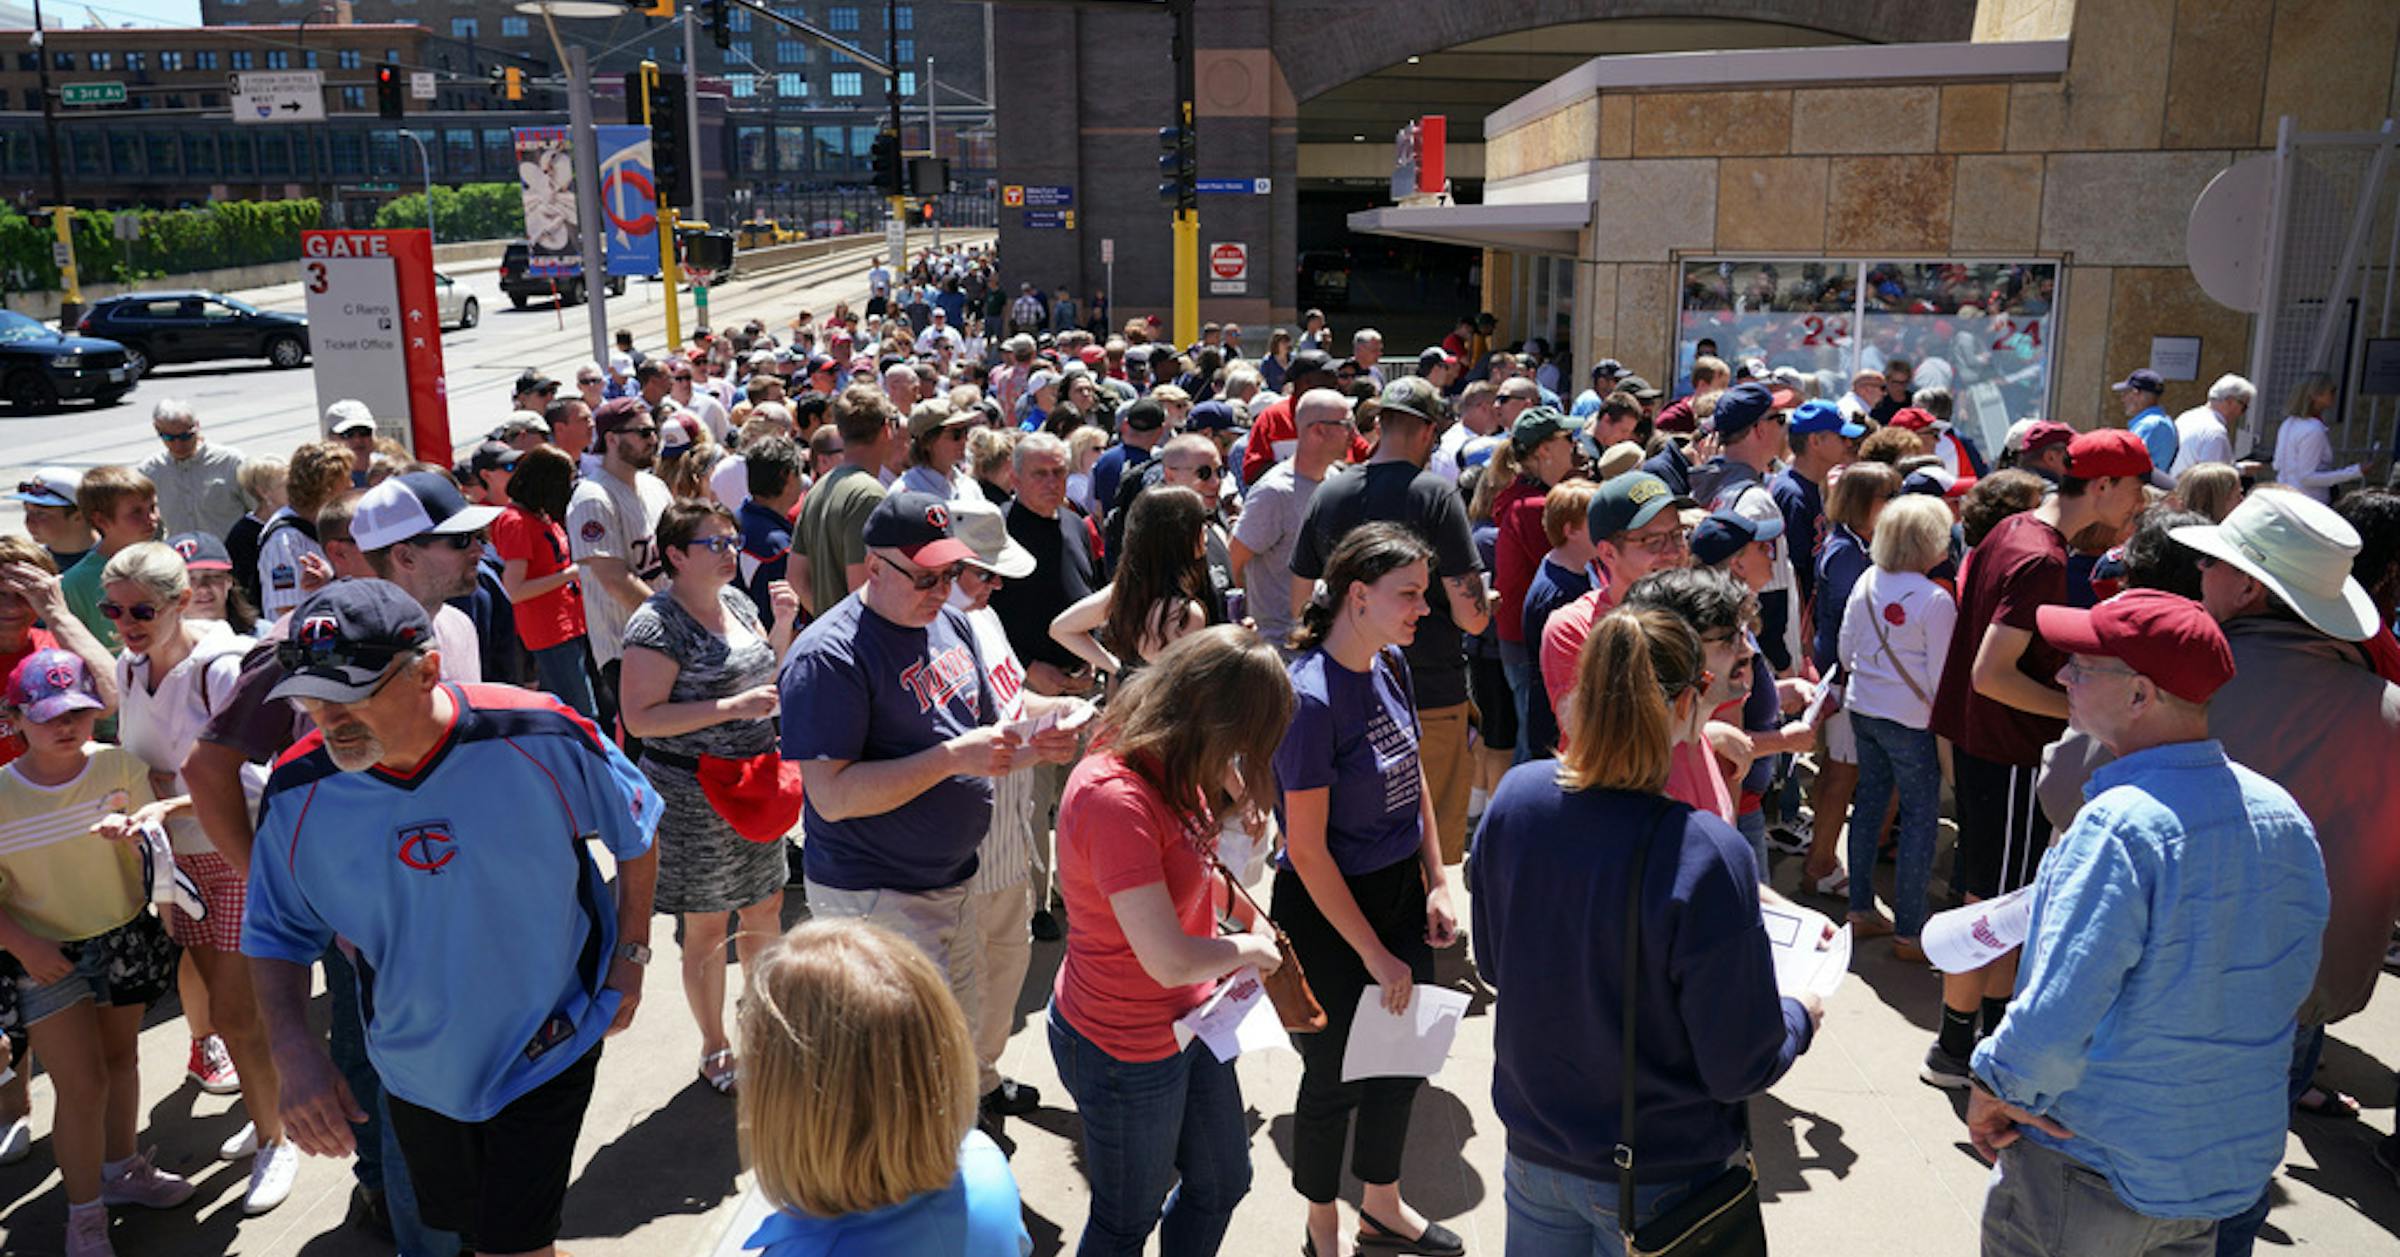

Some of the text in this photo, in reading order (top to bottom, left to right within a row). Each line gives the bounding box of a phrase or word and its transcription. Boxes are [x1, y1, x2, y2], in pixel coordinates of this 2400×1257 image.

[64, 88, 121, 99] N 3rd Av
[306, 235, 389, 258] GATE
[307, 262, 329, 294] 3
[343, 304, 390, 317] C Ramp
[324, 339, 394, 351] Ticket Office
[1803, 315, 1849, 348] 23
[1993, 318, 2042, 350] 24
[899, 645, 975, 715] Twins
